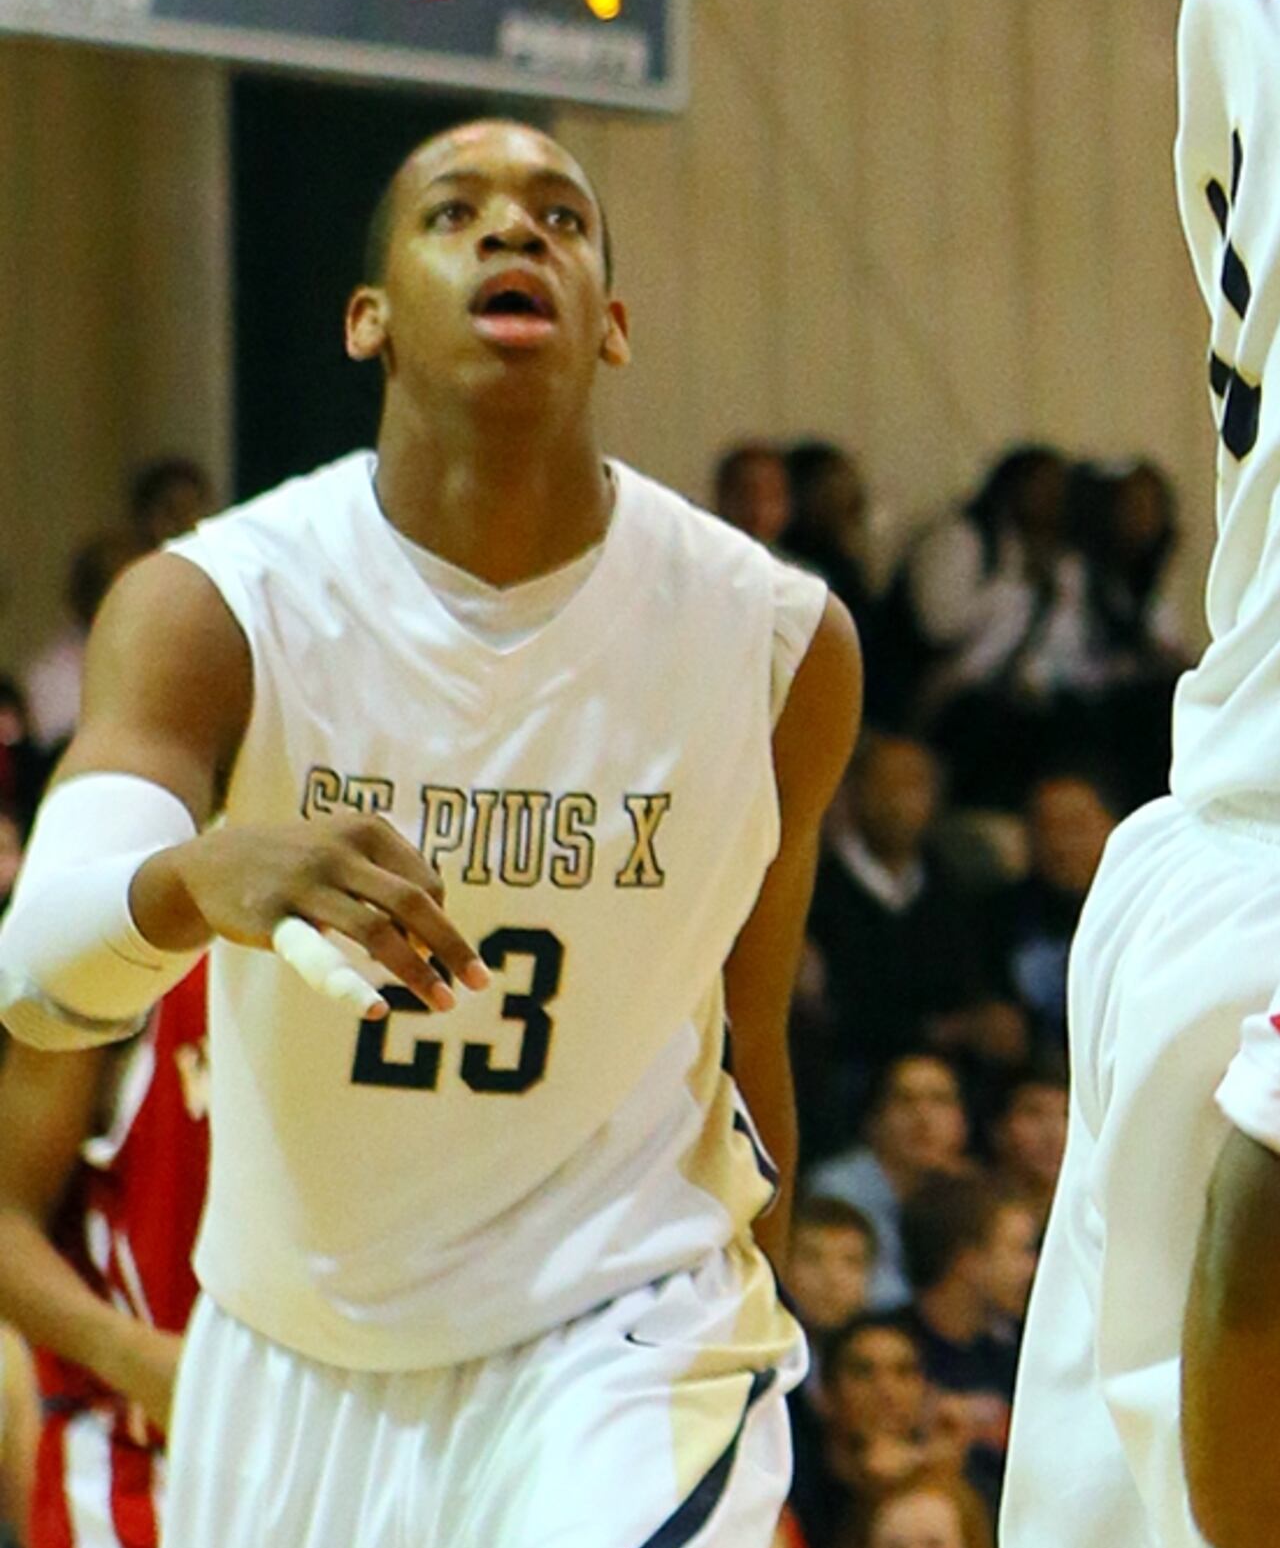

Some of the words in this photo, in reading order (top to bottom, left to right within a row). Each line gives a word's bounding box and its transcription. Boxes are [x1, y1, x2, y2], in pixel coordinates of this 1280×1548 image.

[420, 785, 598, 889] PIUS
[615, 792, 673, 888] X
[350, 927, 566, 1095] 23
